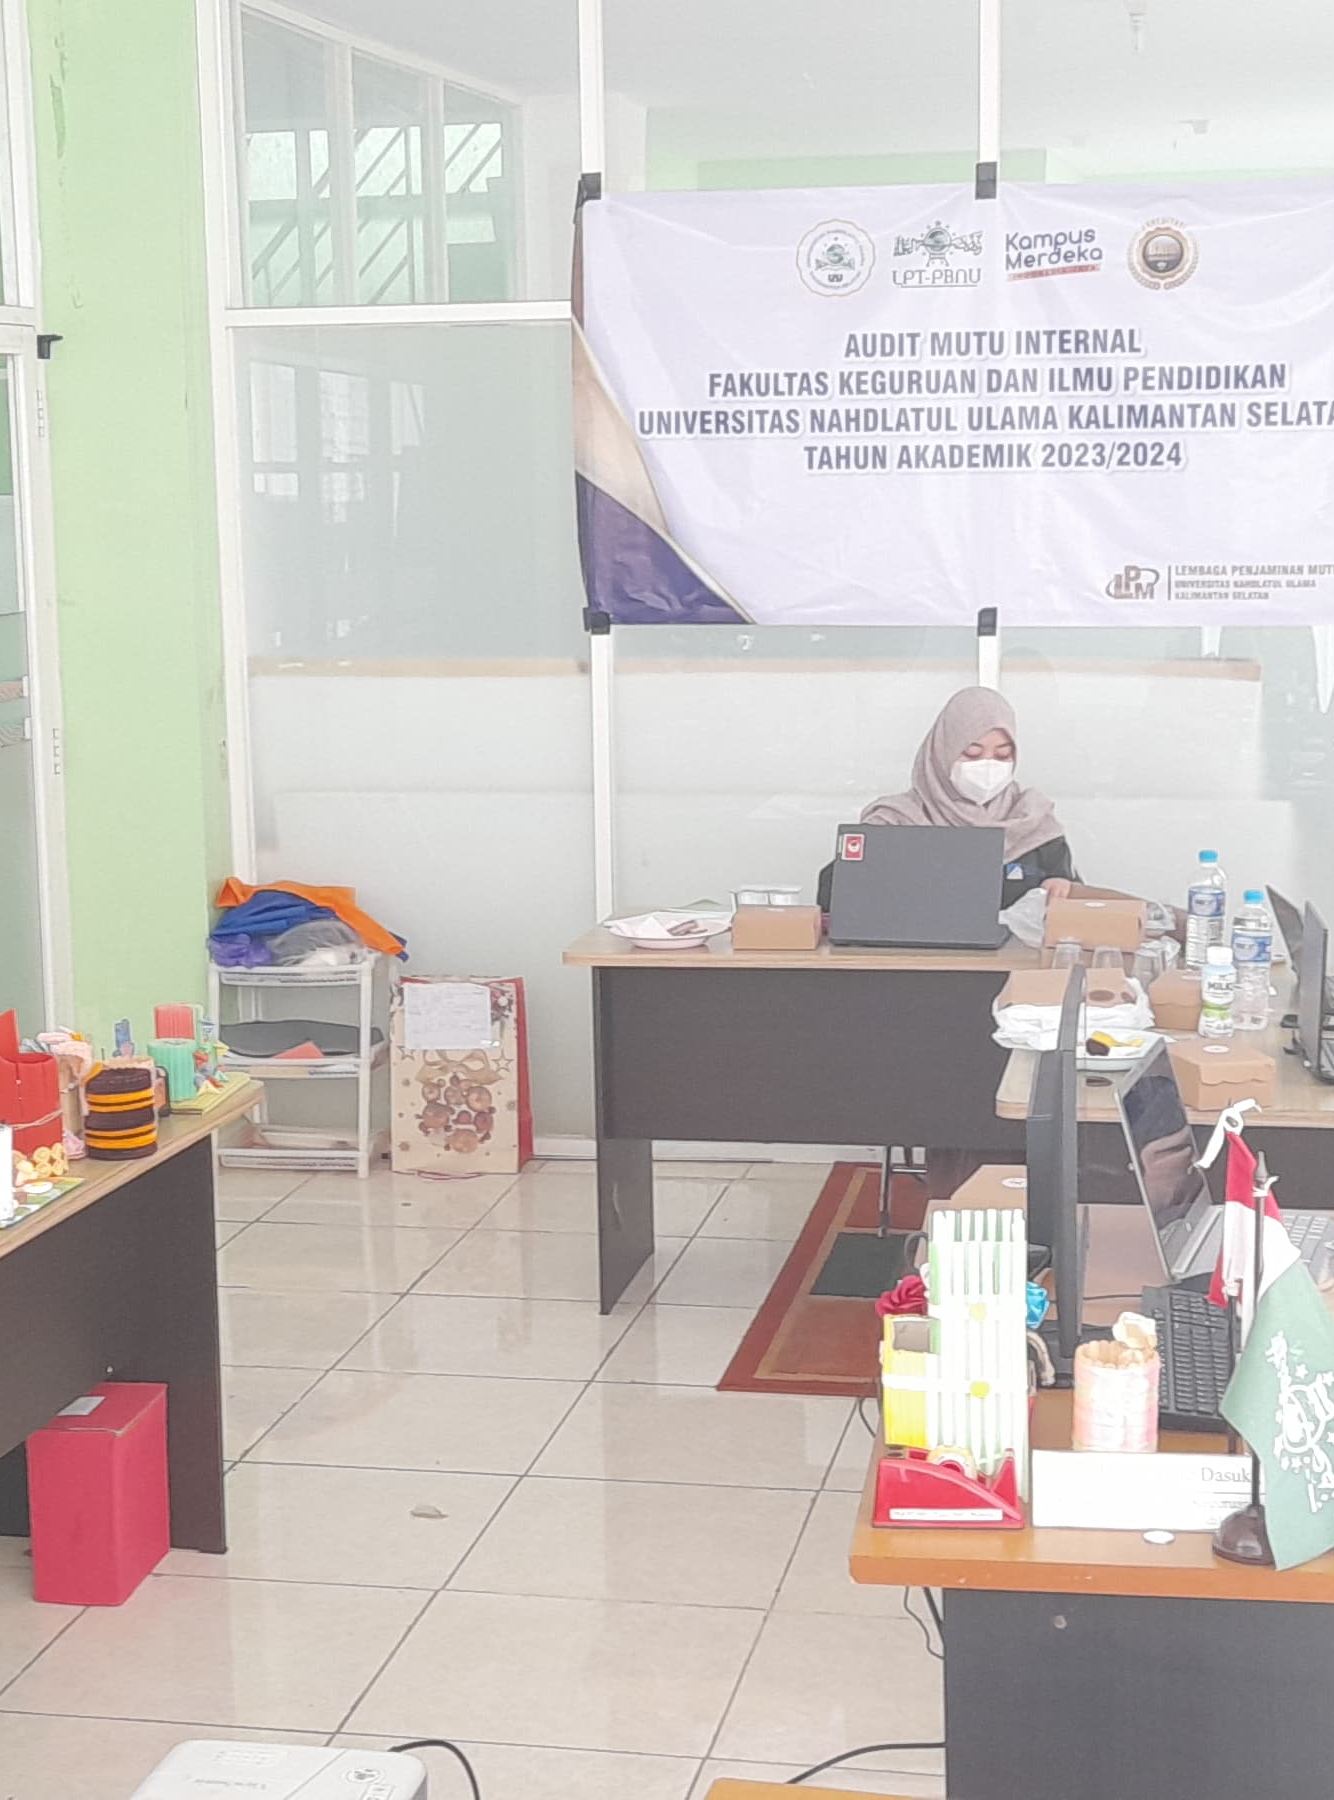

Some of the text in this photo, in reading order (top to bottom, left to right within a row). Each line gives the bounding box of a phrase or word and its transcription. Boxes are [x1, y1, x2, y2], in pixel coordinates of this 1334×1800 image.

[1005, 228, 1096, 252] Kampus
[1005, 246, 1103, 271] Merdeka
[845, 329, 1141, 358] AUDIT MUTU INTERNAL
[709, 363, 1286, 398] FAKULTAS KEGURUAN DAN ILMU PENDIDIKAN
[639, 408, 800, 435] UNIVERSITAS
[809, 406, 957, 433] NAHDLATUL
[967, 405, 1058, 432] ULAMA
[1068, 402, 1236, 430] KALIMANTAN
[804, 441, 1182, 470] TAHUN AKADEMIK 2023/2024
[1175, 565, 1227, 576] LEMBAGA
[1231, 565, 1304, 576] PENJAMINAN
[1201, 1466, 1253, 1482] Dasuk
